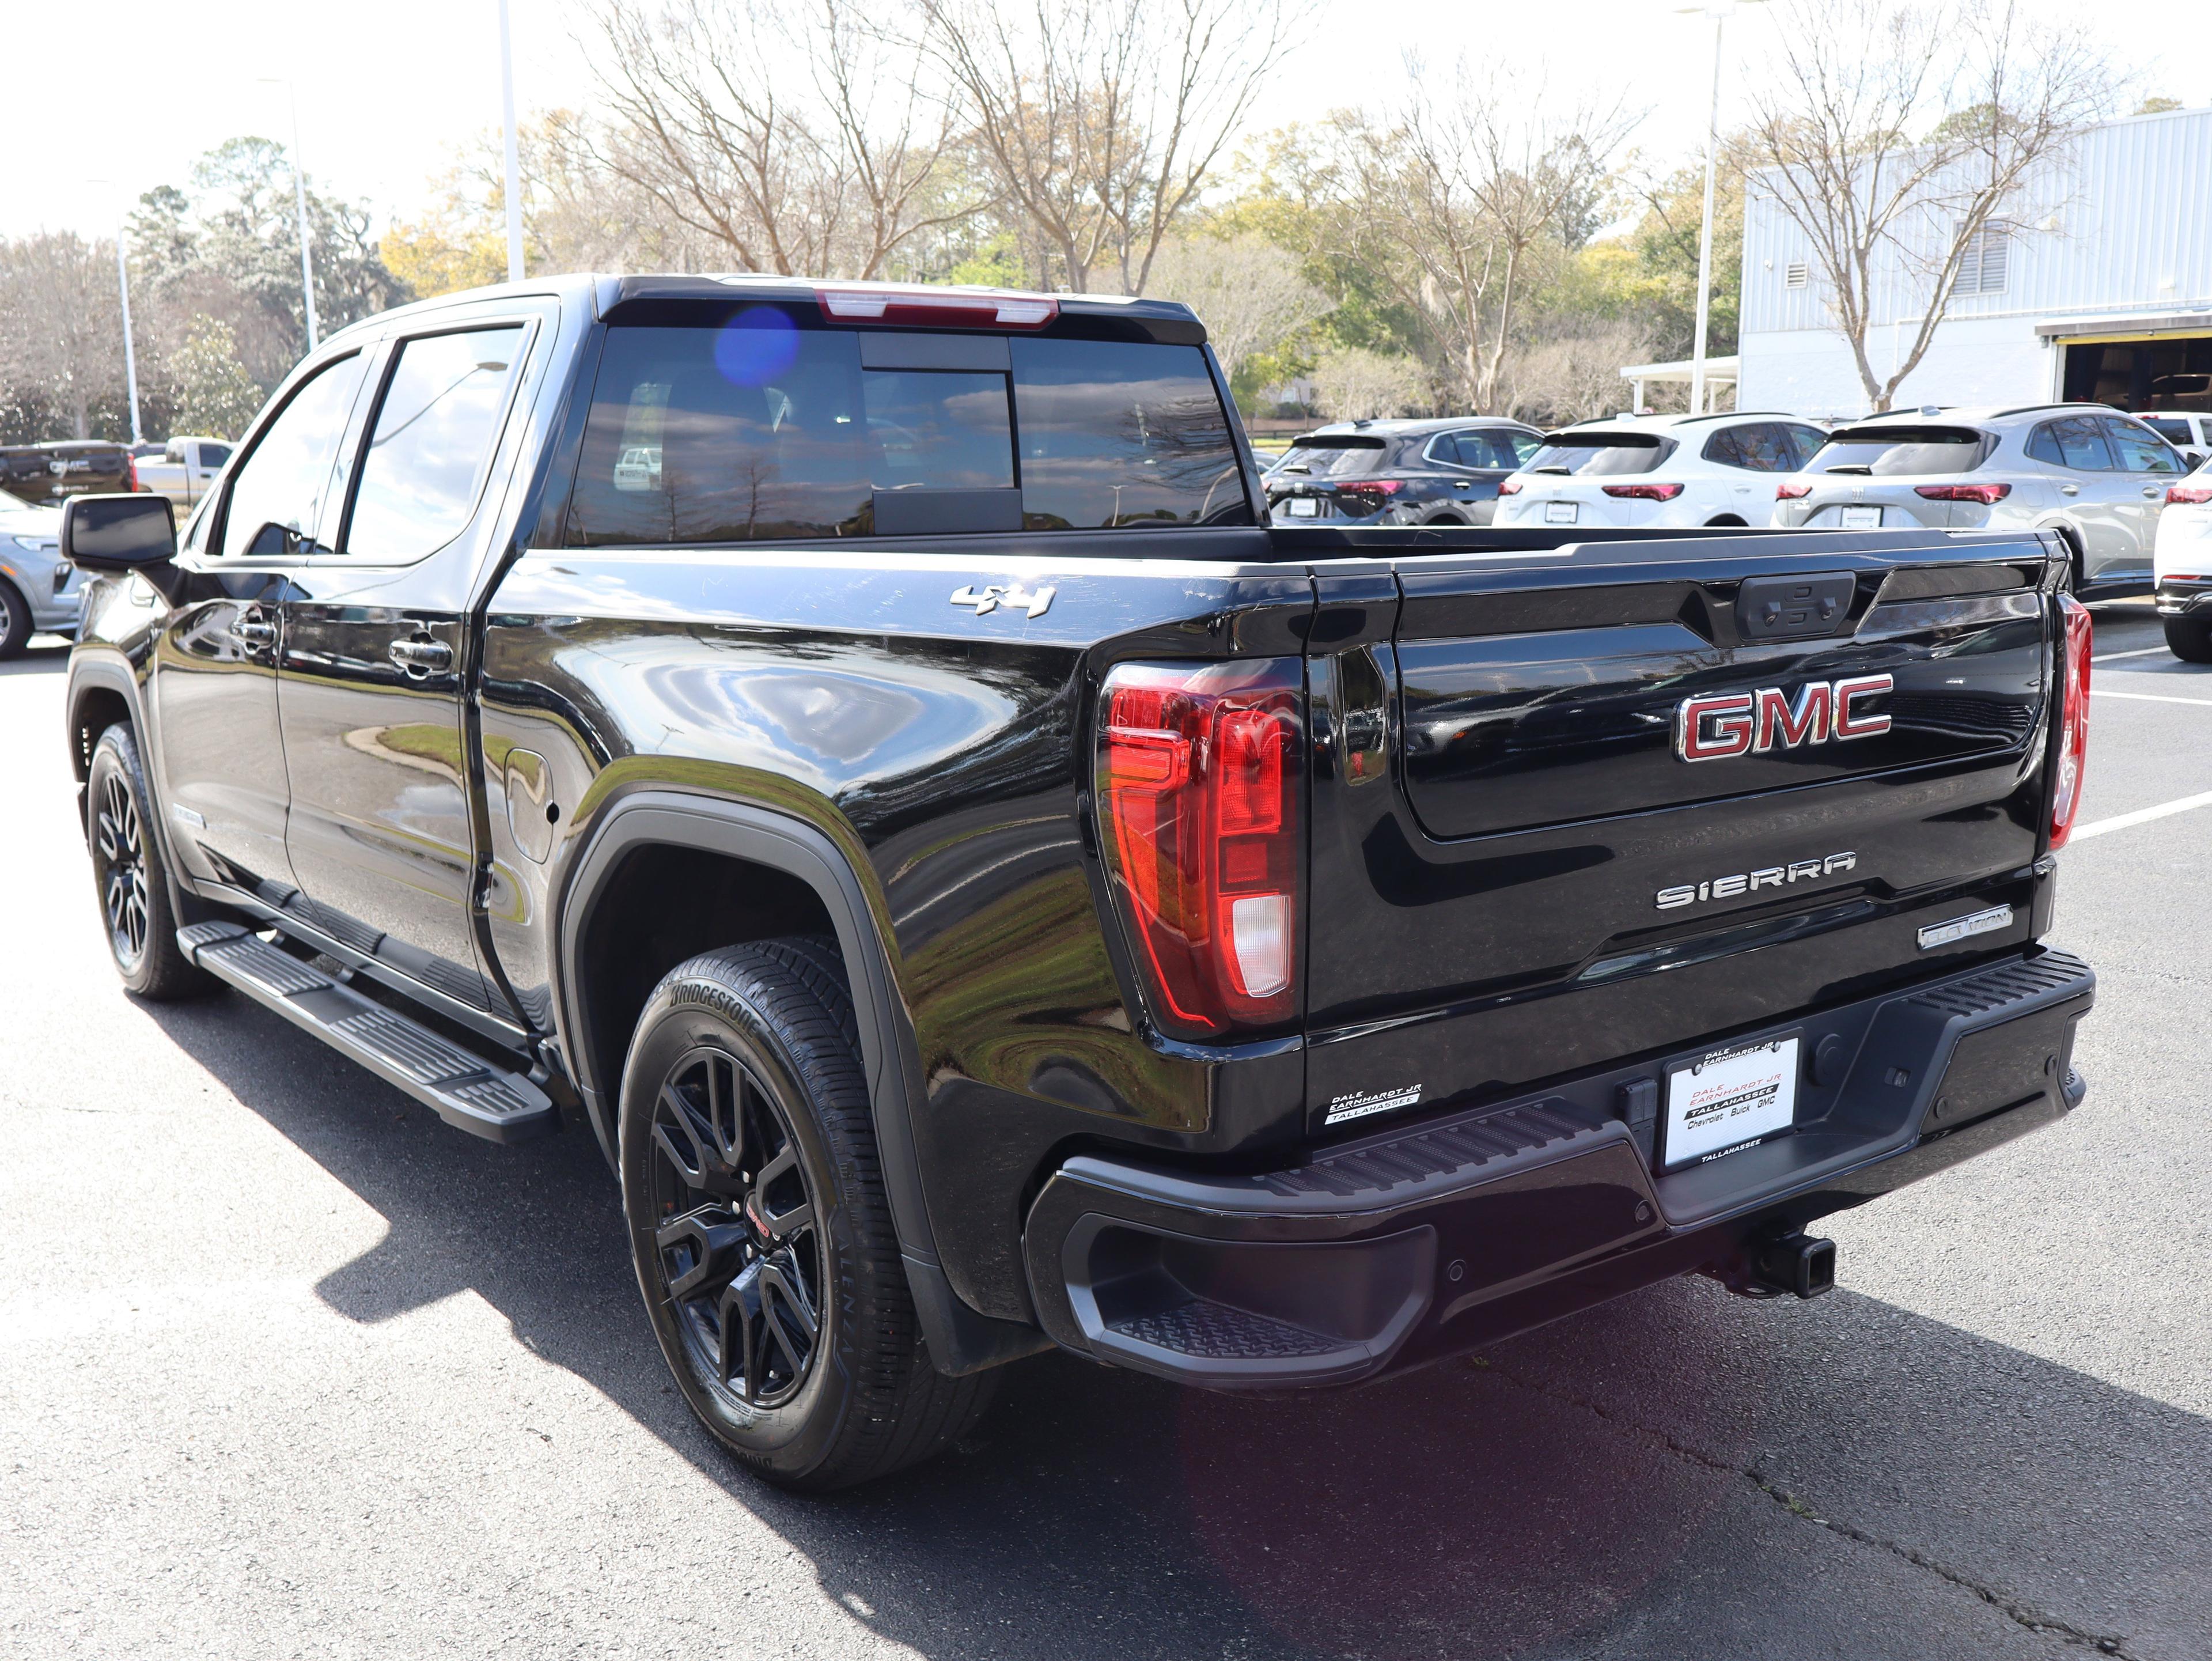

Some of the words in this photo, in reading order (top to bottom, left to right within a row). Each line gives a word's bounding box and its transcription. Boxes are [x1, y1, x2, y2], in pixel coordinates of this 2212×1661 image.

[1675, 673, 1894, 764] GMC
[1654, 851, 1857, 910] SIERRA
[669, 983, 762, 1038] BRIDGESTONE
[1702, 1046, 1759, 1067] EARNHARDT
[1761, 1042, 1774, 1050] JR
[1705, 1048, 1730, 1060] DALE
[1329, 1088, 1404, 1111] EARNHARDT
[1406, 1084, 1422, 1092] JR
[1332, 1091, 1363, 1103] DALE
[1690, 1079, 1764, 1106] EARNHARDT
[1766, 1073, 1782, 1083] JR
[1691, 1087, 1774, 1117] TALLAHASSEE
[1692, 1084, 1725, 1098] DALE
[1332, 1096, 1414, 1120] TALLAHASSEE
[1687, 1113, 1724, 1130] Chevrolet
[1730, 1104, 1750, 1117] Buick
[1757, 1095, 1775, 1108] GMC
[1701, 1138, 1762, 1163] TALLAHASSEE
[838, 1235, 856, 1353] ALENZA
